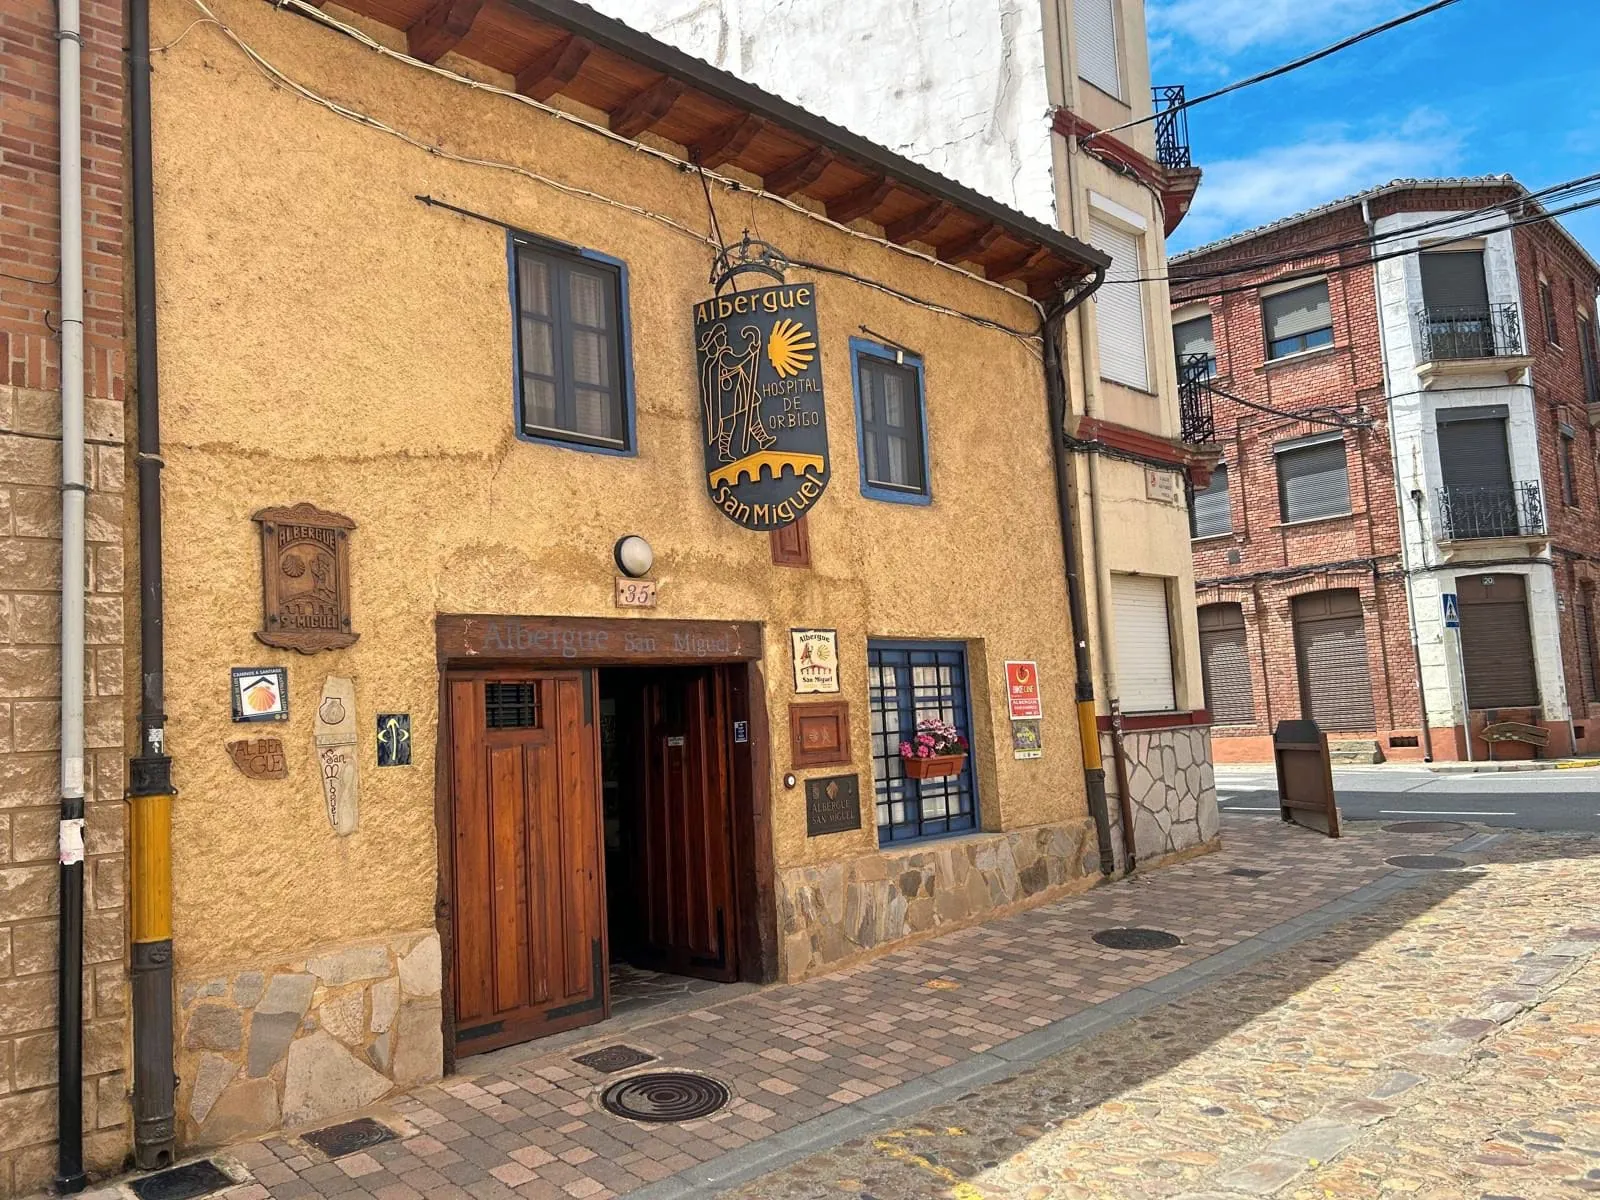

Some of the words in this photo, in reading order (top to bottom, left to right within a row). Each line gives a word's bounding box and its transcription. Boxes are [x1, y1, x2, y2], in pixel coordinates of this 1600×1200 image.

[696, 287, 811, 325] Albergue
[762, 378, 821, 398] HOSPITAL
[783, 398, 801, 412] DE
[769, 412, 819, 430] ORBIGO
[712, 486, 750, 524] San
[753, 473, 824, 525] Miguel
[279, 526, 336, 548] ALBERGUE
[624, 584, 651, 604] 35
[483, 619, 609, 657] Albergue
[624, 632, 656, 651] San
[673, 631, 730, 657] Miguel
[799, 634, 831, 643] Albergue
[322, 748, 346, 764] San
[812, 799, 849, 813] ALBERGUE
[812, 815, 827, 825] SAN
[829, 808, 854, 822] MIGUEL
